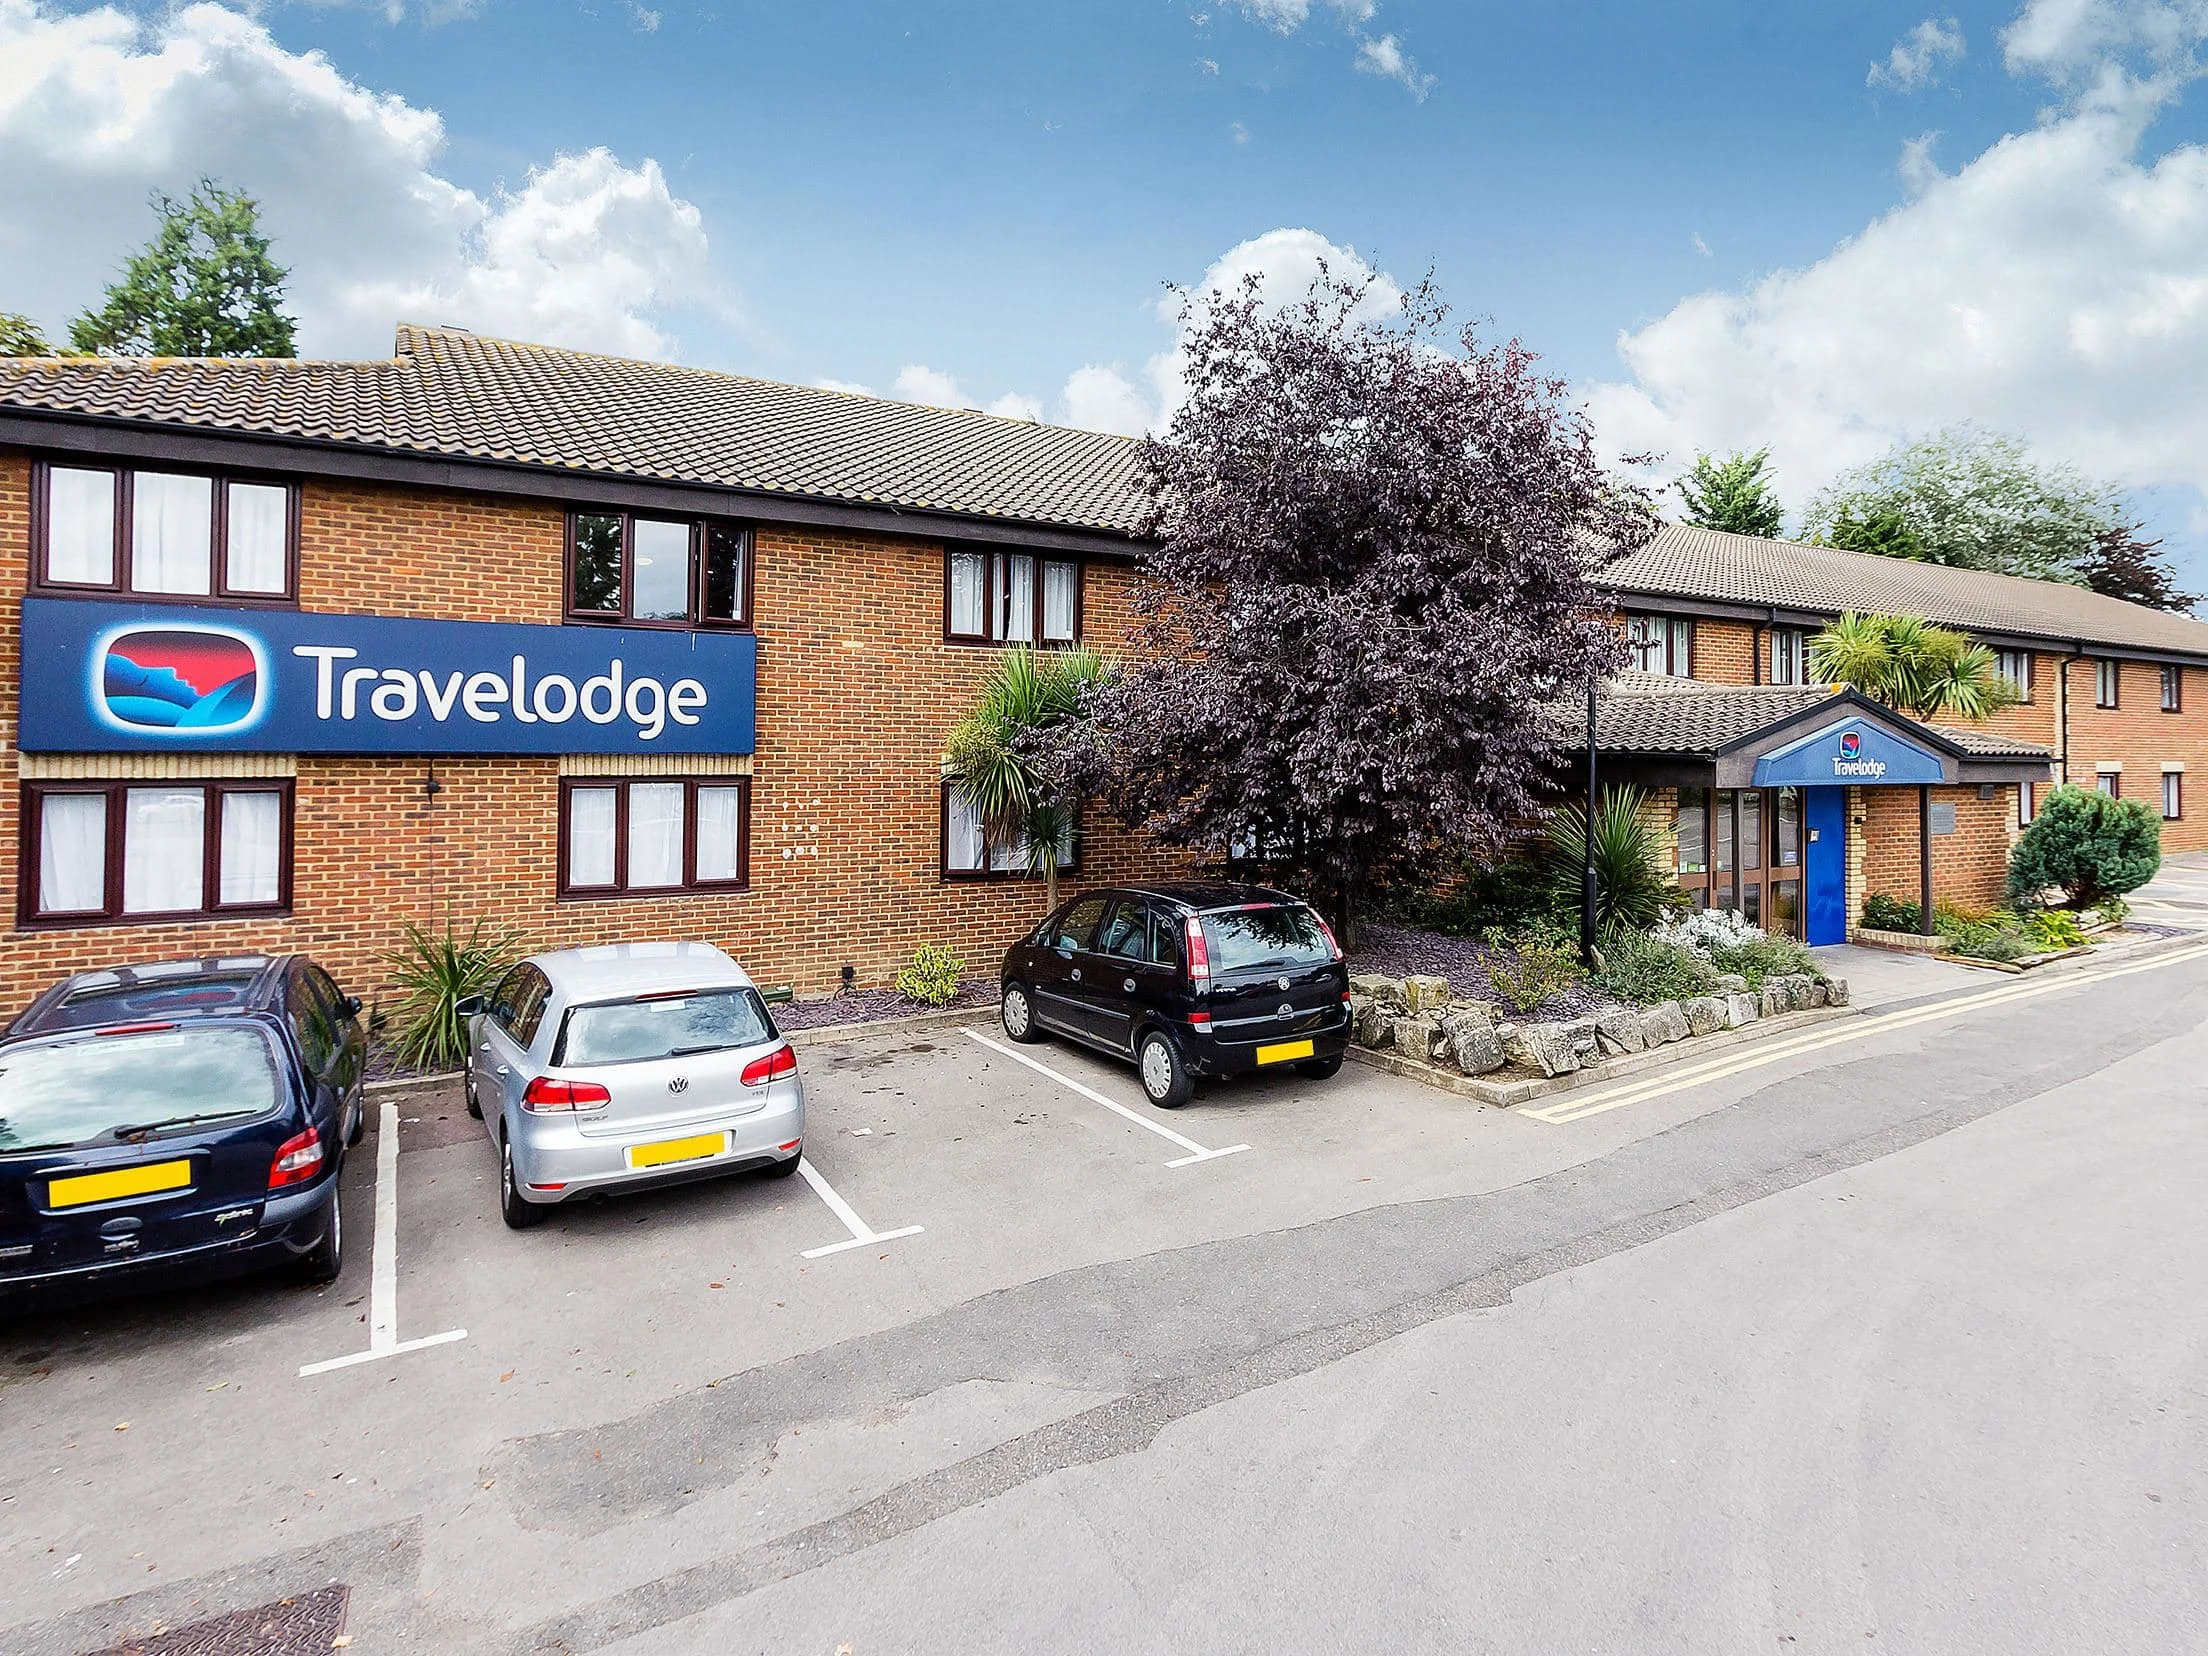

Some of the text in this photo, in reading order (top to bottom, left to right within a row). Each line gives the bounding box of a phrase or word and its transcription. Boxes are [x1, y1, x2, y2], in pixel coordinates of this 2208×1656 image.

[292, 645, 708, 740] Travelodge
[1831, 757, 1886, 779] Travelodge
[667, 1075, 690, 1096] VW
